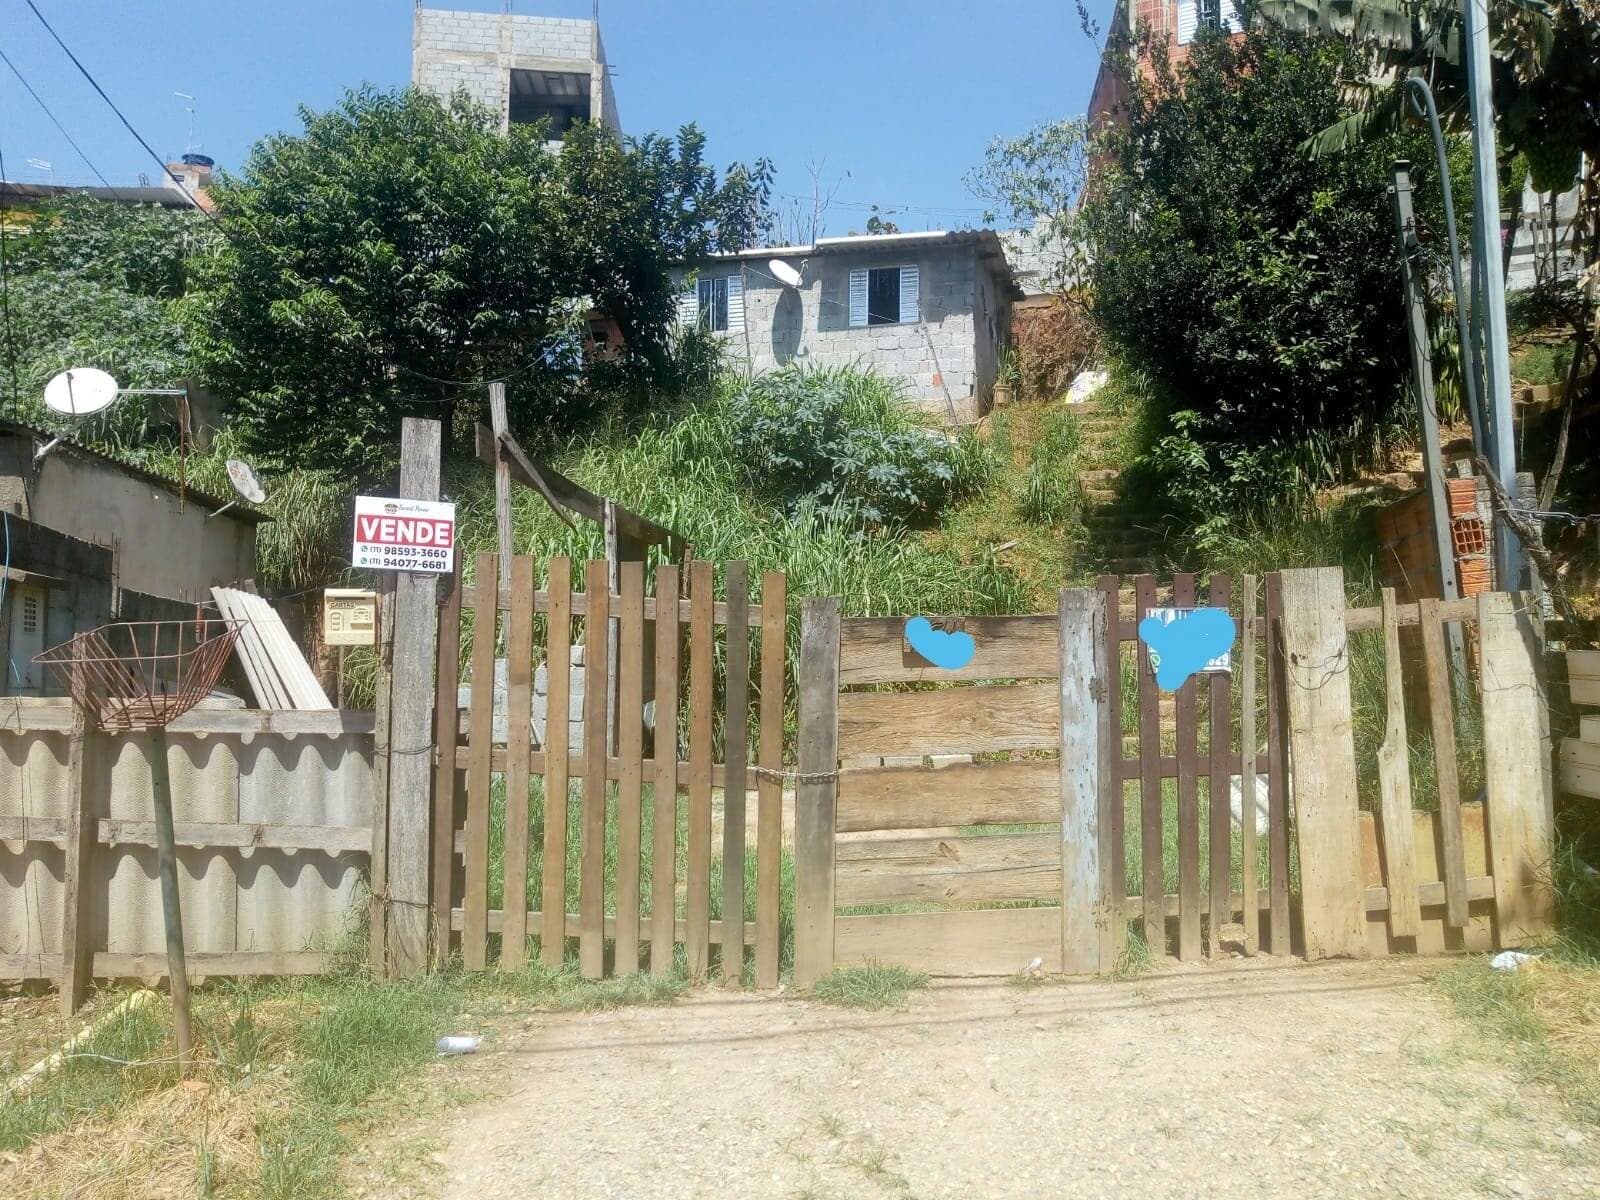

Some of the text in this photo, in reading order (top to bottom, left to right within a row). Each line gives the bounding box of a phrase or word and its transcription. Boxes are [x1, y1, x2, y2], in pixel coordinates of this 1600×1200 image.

[361, 517, 451, 545] VENDE
[384, 546, 448, 558] 98593-3660
[383, 558, 447, 569] 94077-6681
